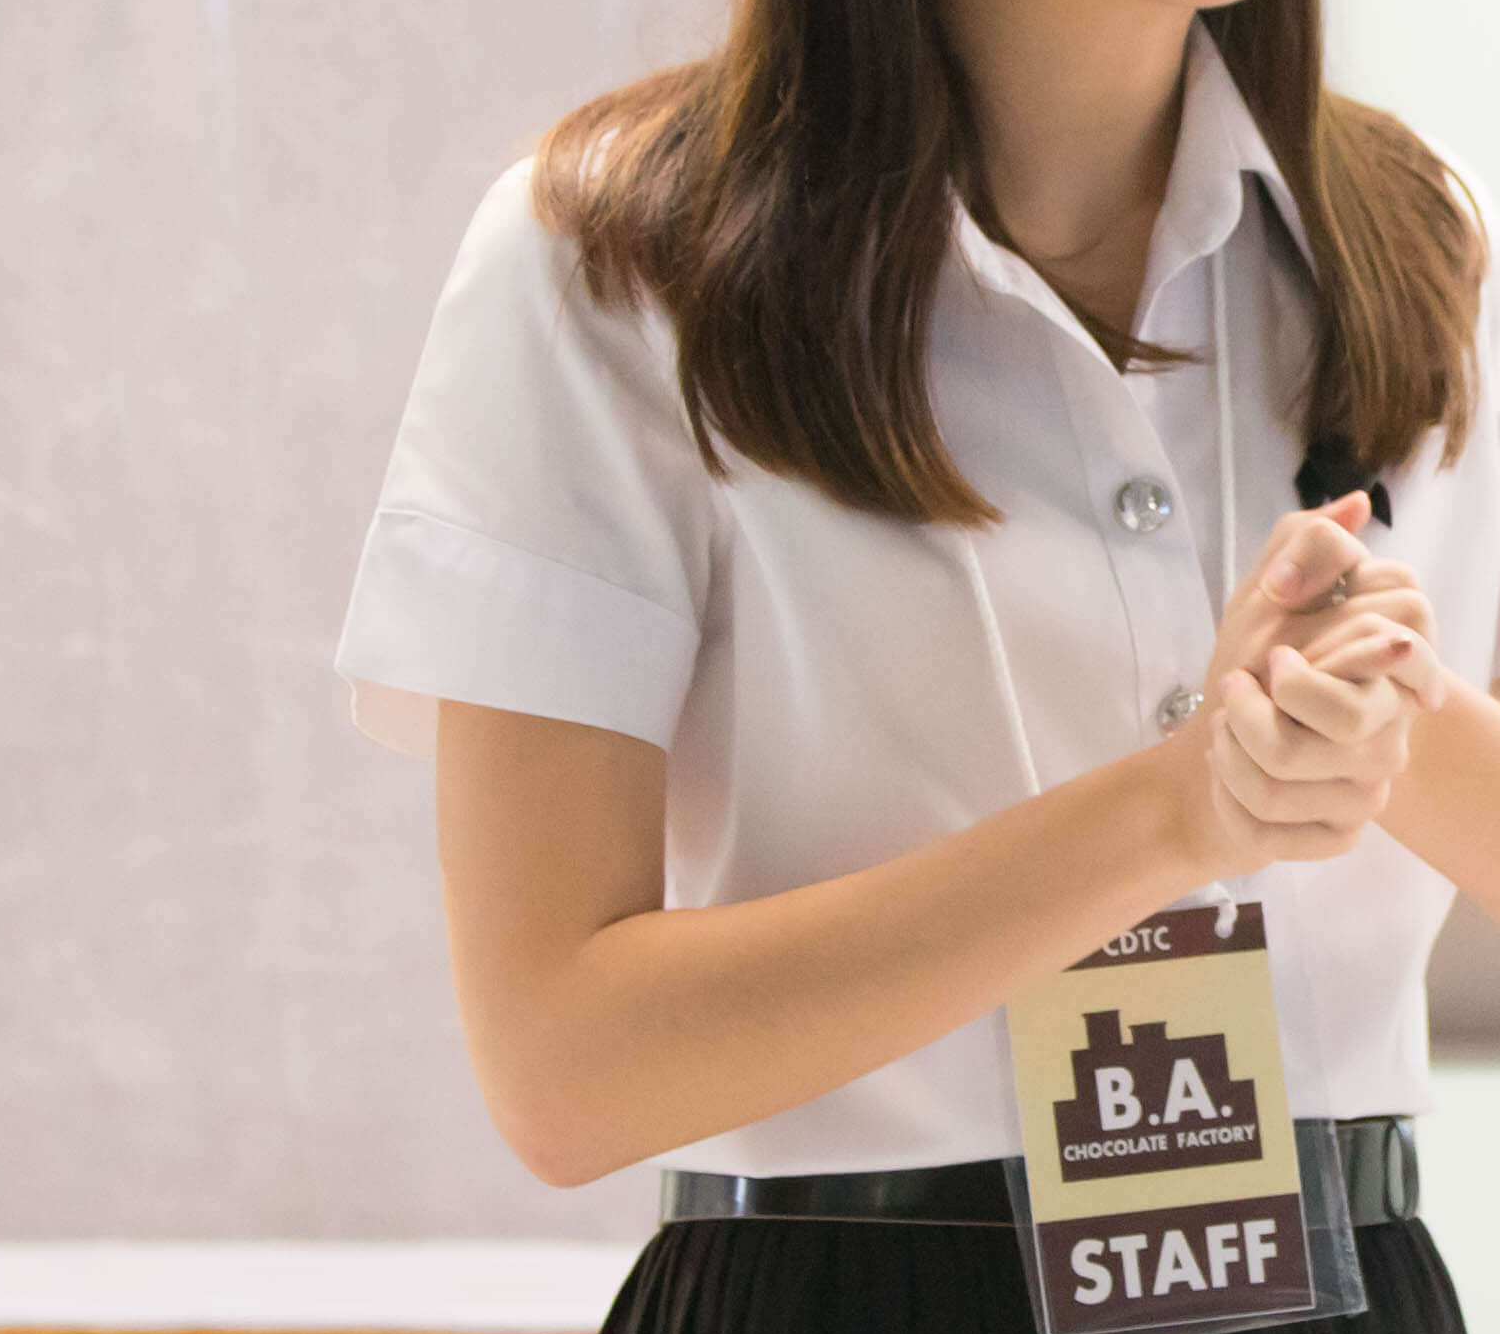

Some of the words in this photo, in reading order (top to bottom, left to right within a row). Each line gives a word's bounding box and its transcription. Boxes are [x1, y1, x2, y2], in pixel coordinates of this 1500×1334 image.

[1102, 925, 1172, 957] CDTC
[1094, 1057, 1233, 1132] B.A.
[1063, 1133, 1168, 1163] CHOCOLATE
[1176, 1123, 1256, 1150] FACTORY
[1069, 1218, 1279, 1307] STAFF
